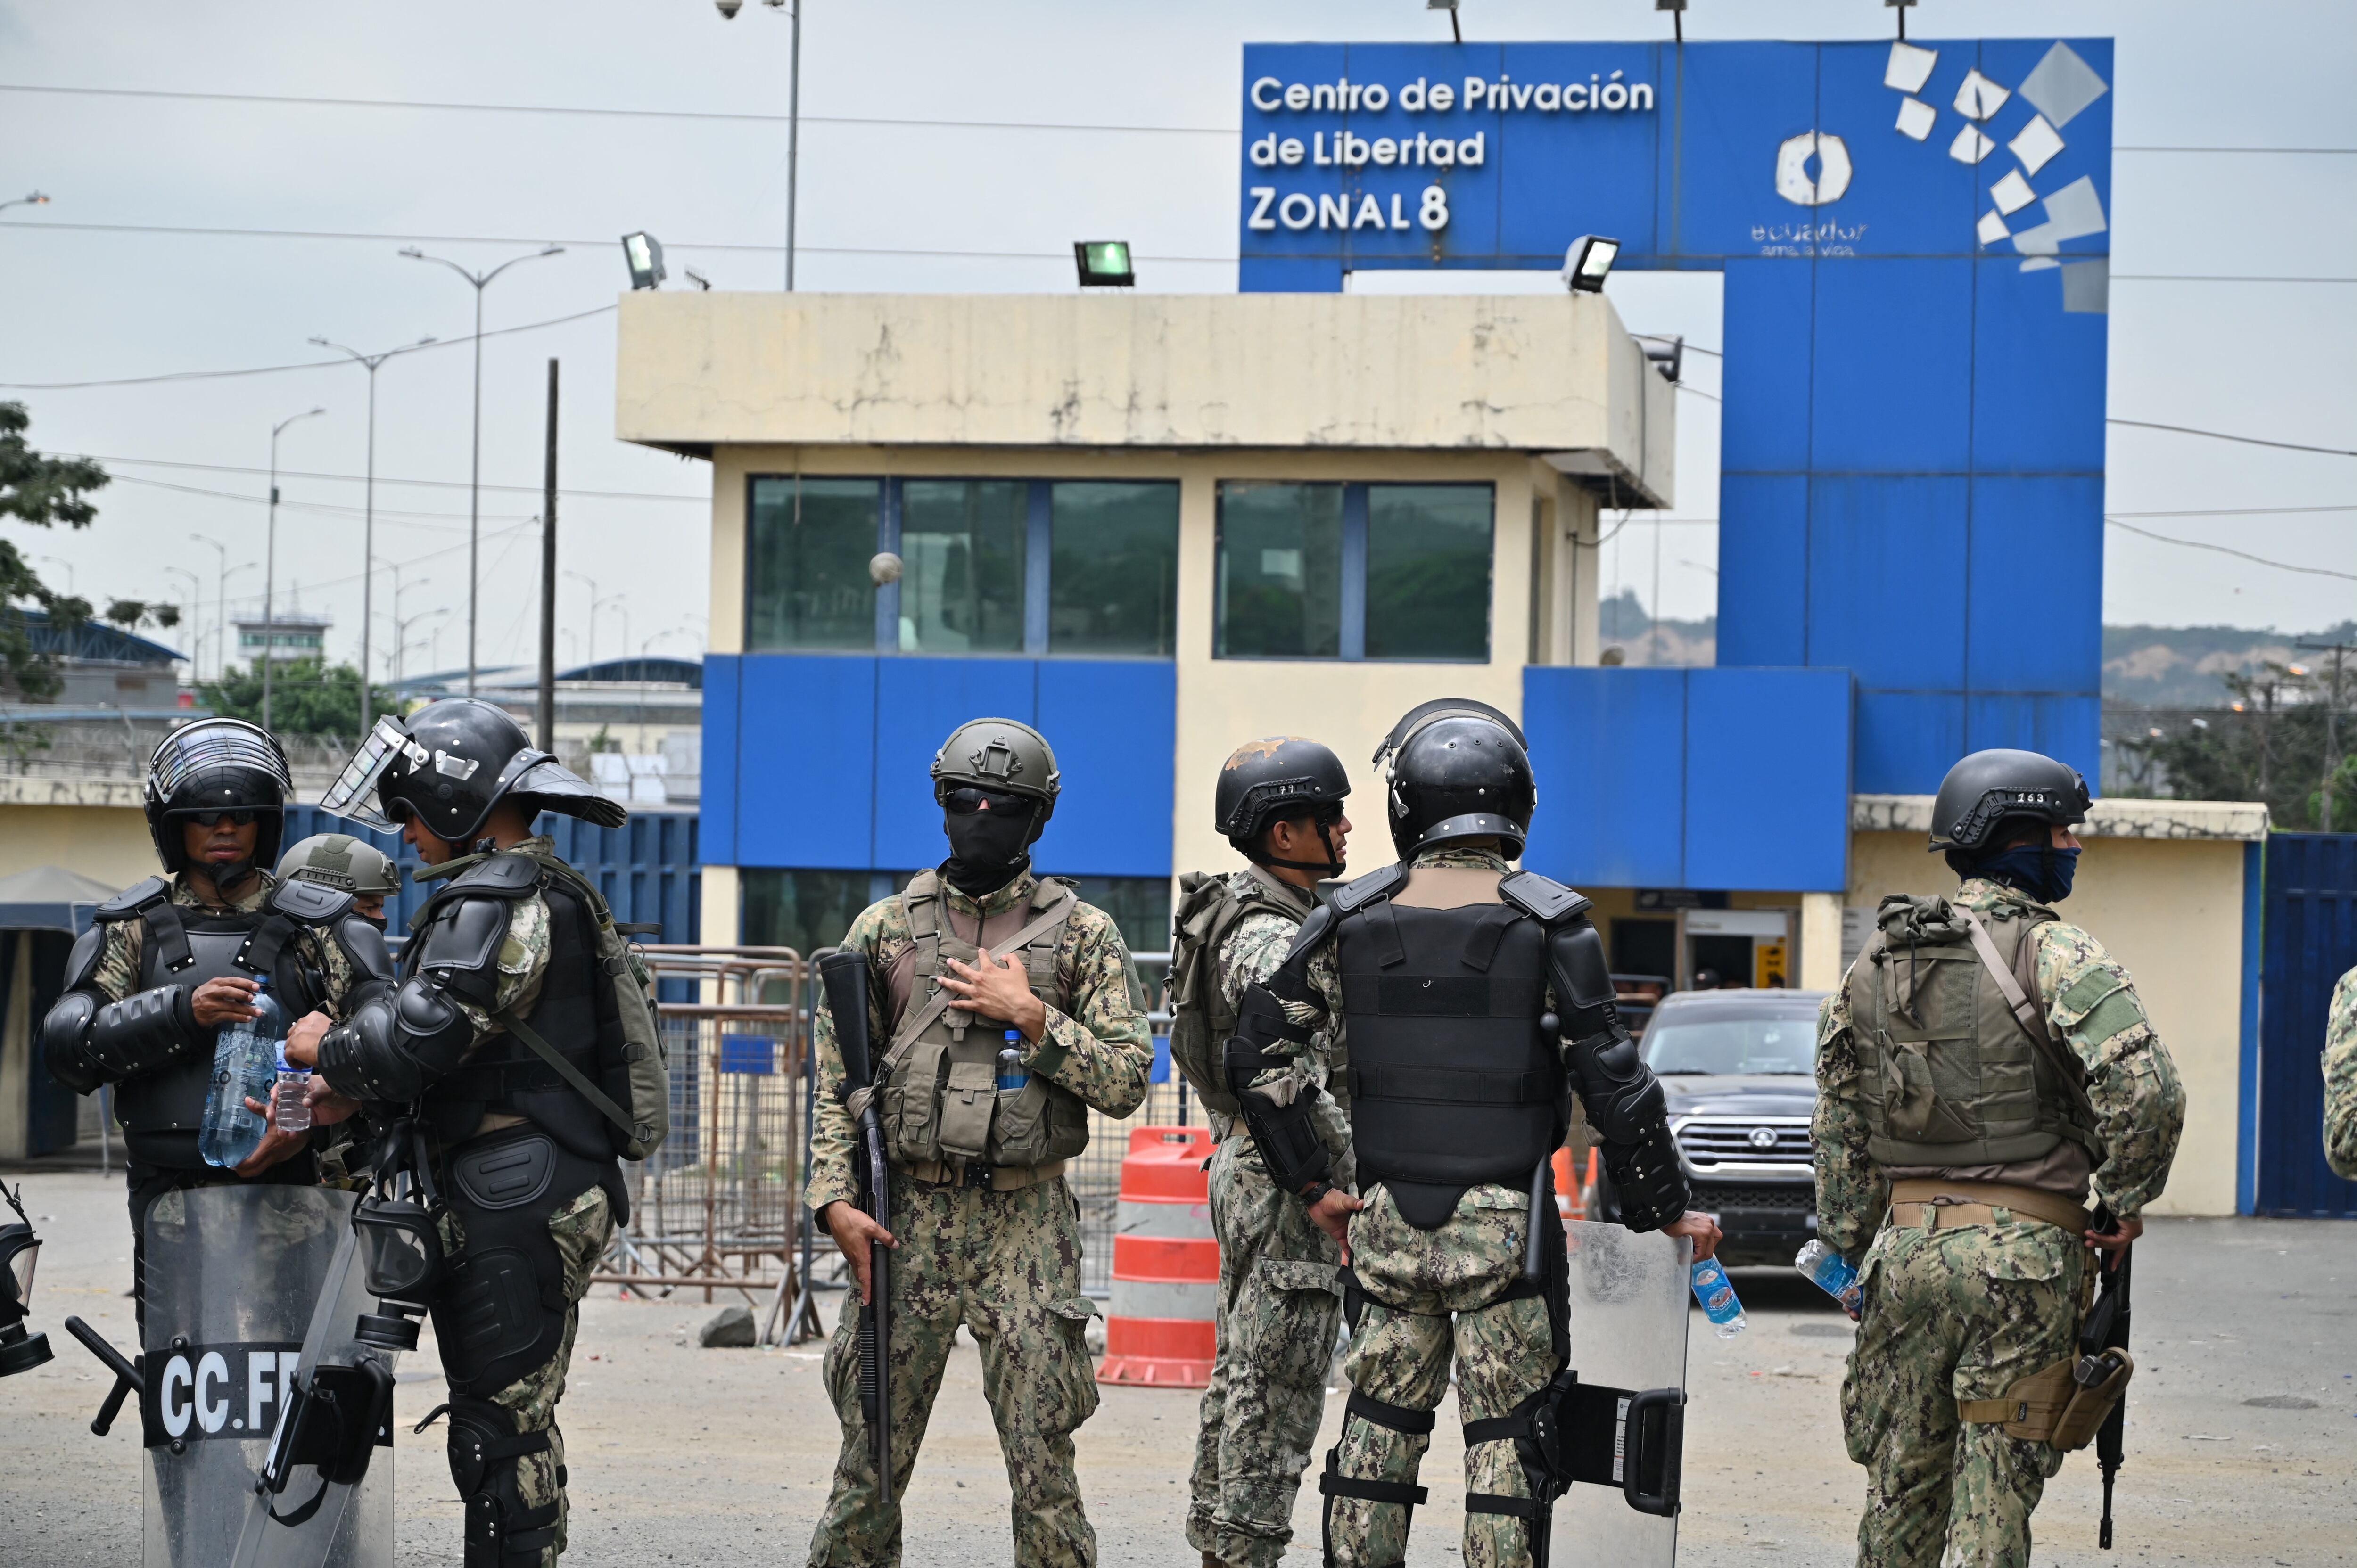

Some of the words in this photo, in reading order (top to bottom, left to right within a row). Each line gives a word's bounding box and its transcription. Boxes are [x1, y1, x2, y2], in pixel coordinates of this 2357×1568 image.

[1251, 77, 1389, 111] Centro
[1399, 77, 1454, 111] de
[1464, 70, 1654, 110] Privación
[1249, 132, 1305, 165] de
[1313, 131, 1484, 165] Libertad
[1248, 187, 1410, 229] ZONAL
[1419, 185, 1449, 230] 8
[1279, 784, 1294, 795] 79
[2017, 792, 2044, 803] 163
